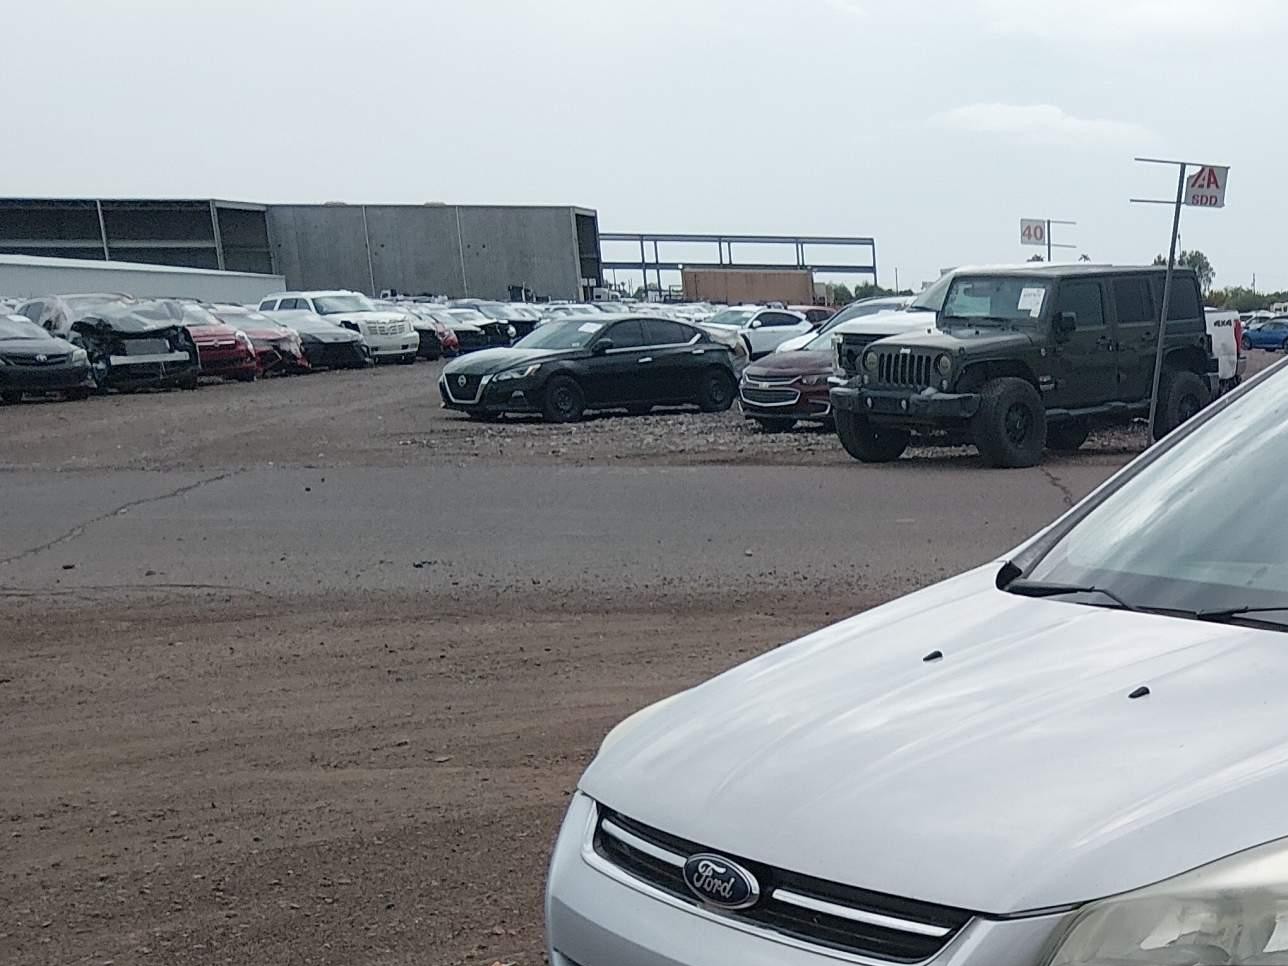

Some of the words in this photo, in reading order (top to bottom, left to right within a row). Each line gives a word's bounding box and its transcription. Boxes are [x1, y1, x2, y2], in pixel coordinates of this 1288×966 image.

[1191, 194, 1218, 206] SDD
[1022, 224, 1044, 241] 40
[693, 860, 735, 898] Ford
